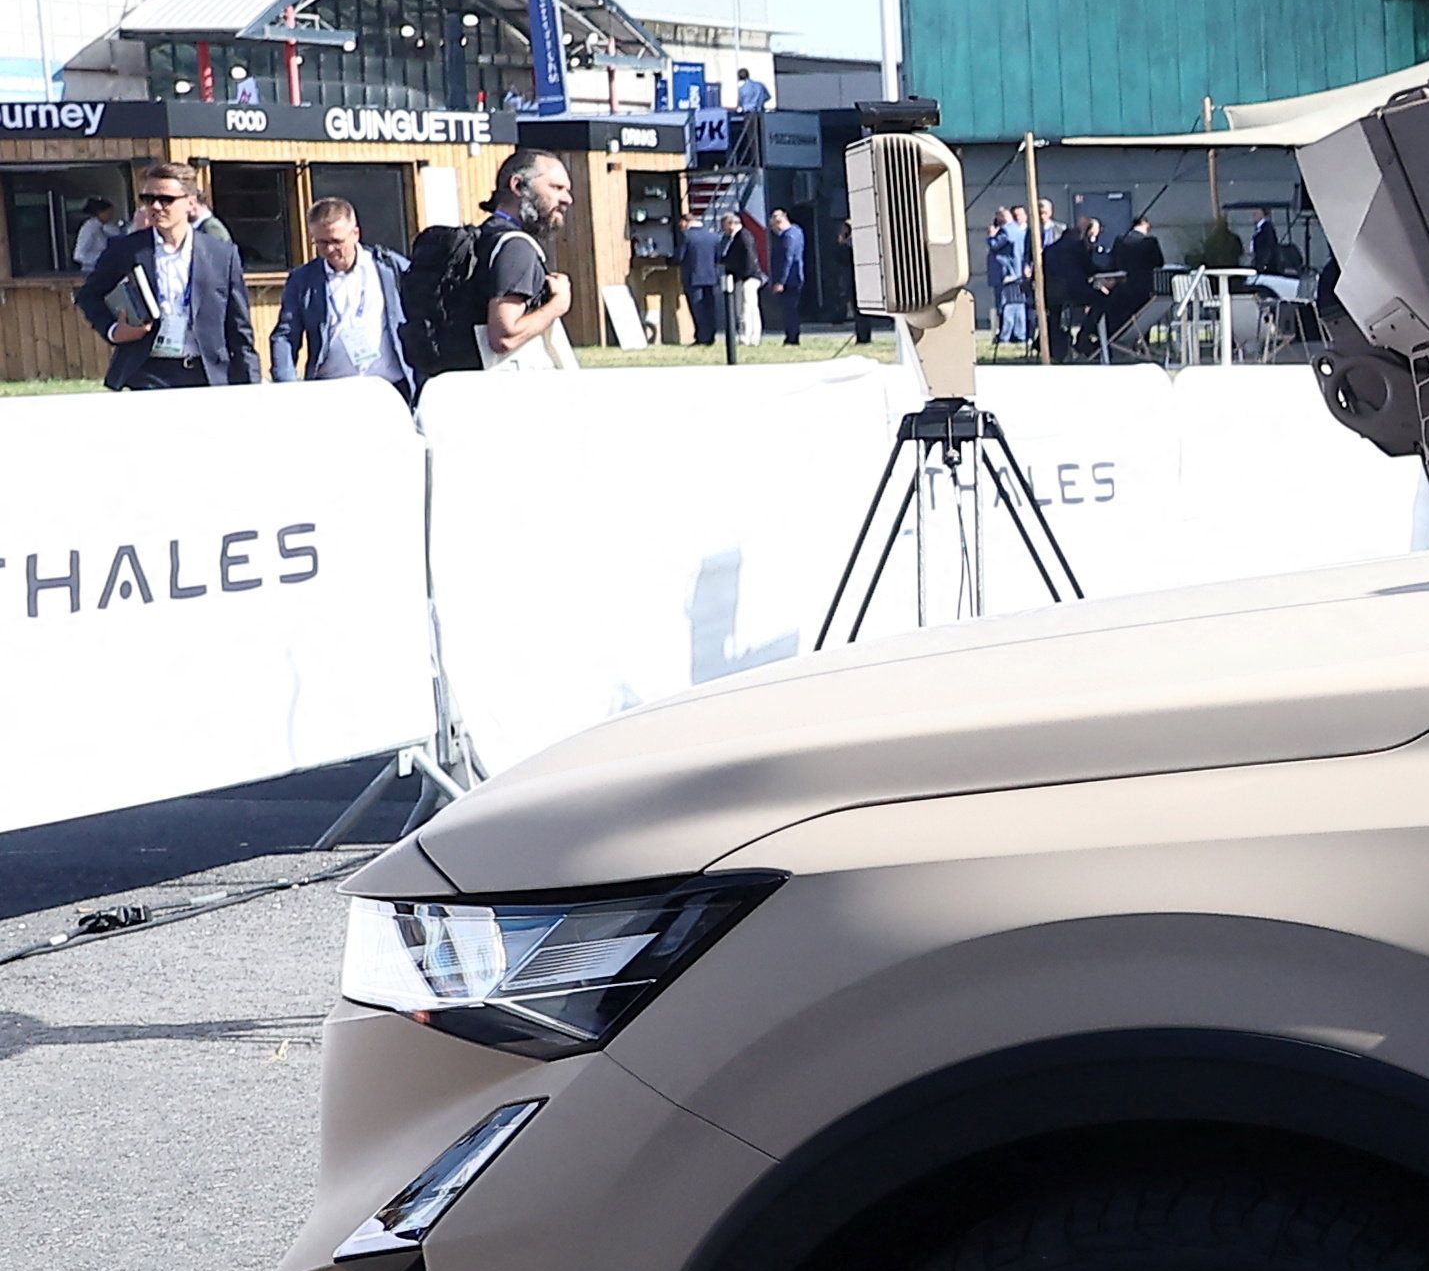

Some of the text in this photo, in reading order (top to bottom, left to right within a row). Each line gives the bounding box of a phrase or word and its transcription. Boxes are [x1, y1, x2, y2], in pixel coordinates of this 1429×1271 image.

[0, 103, 104, 135] urney
[226, 107, 492, 142] FOOD GUINGUETTE
[0, 523, 318, 617] HALES
